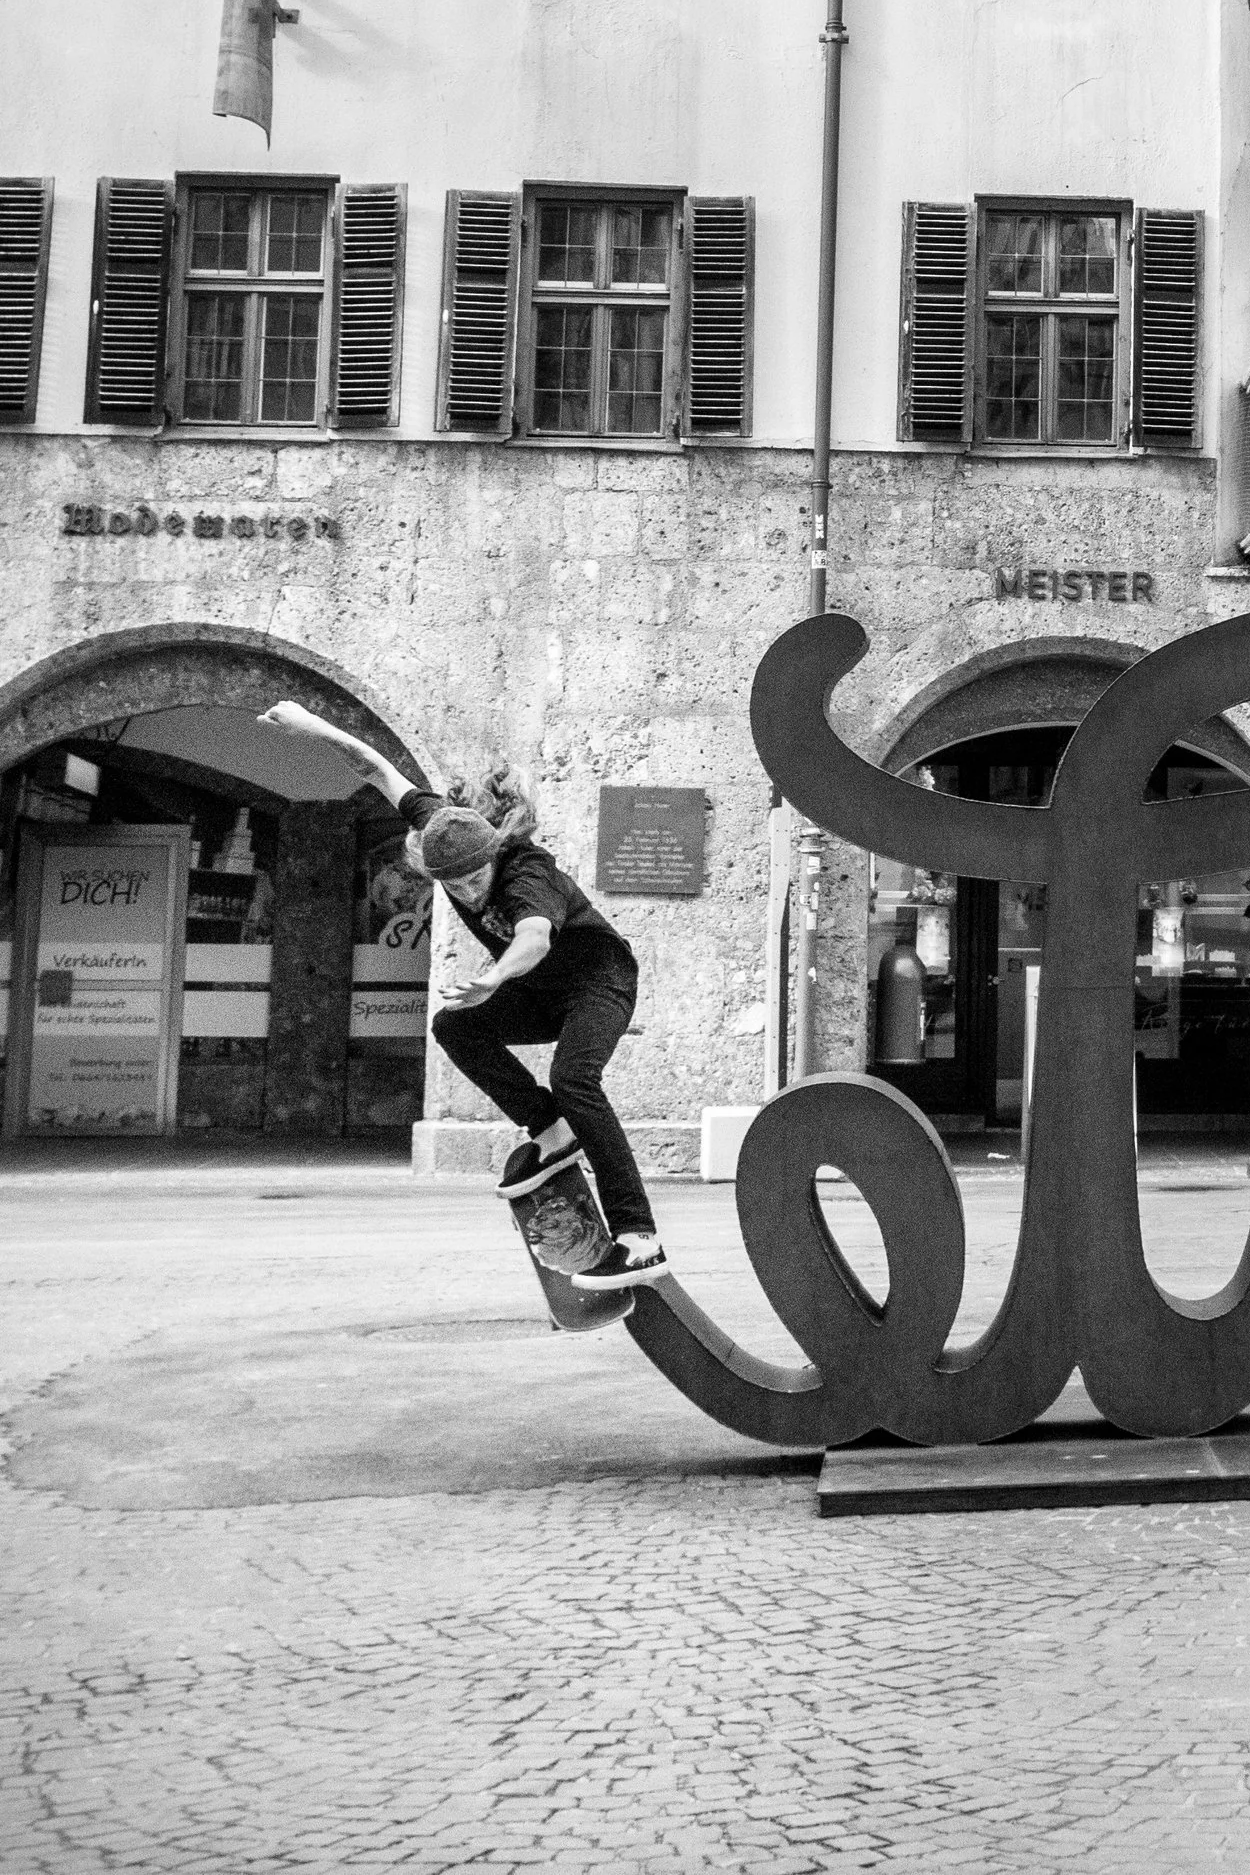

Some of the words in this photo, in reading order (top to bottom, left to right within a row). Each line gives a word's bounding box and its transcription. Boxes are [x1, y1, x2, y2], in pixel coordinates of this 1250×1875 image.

[62, 503, 342, 541] Modewaren
[994, 567, 1154, 603] MEISTER
[60, 879, 142, 906] DICH!
[353, 999, 428, 1019] Spezialit
